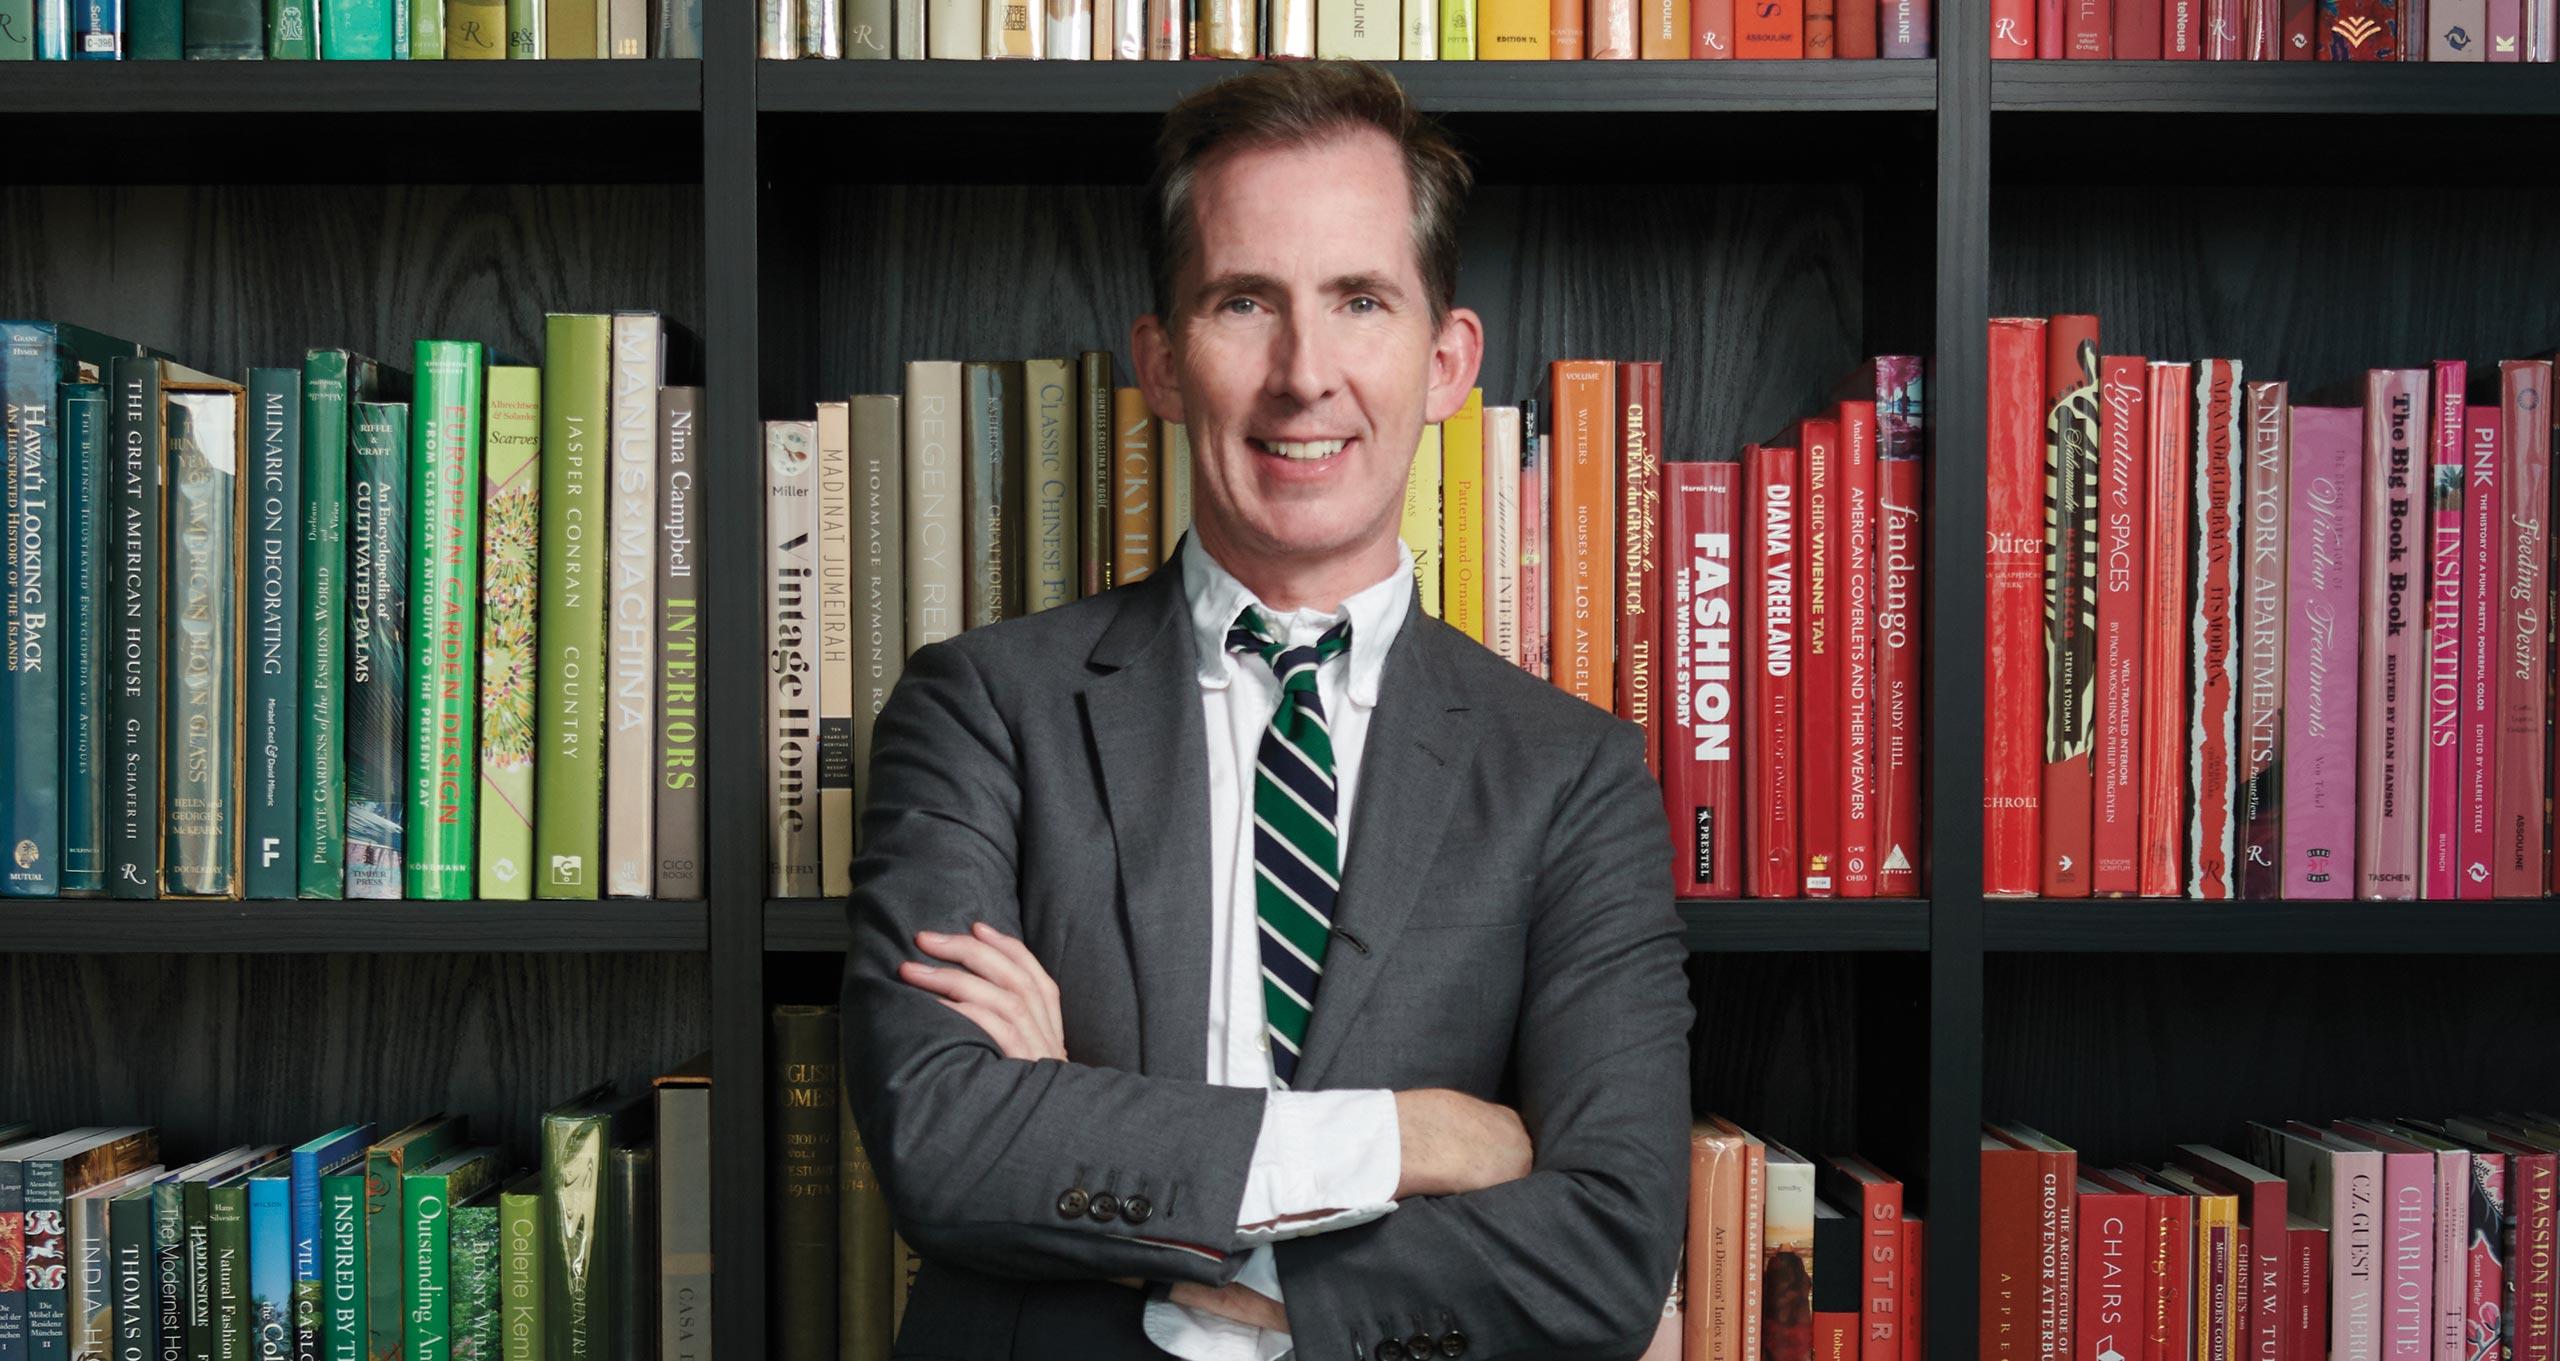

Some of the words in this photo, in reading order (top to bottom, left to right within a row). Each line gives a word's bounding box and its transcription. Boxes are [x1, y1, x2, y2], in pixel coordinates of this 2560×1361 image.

[461, 20, 495, 49] R
[854, 24, 885, 51] R
[1496, 35, 1523, 43] EDITION
[1703, 31, 1724, 51] R
[1996, 17, 2028, 47] R
[2176, 1, 2186, 53] teNeues
[127, 379, 143, 422] THE
[1565, 372, 1600, 381] VOLUME
[8, 403, 21, 422] AN
[489, 431, 540, 447] Scarves
[670, 410, 692, 465] Nina
[1577, 408, 1588, 465] WATTERS
[2103, 368, 2143, 508] Signature
[2256, 404, 2280, 474] NEW
[2391, 392, 2411, 441] The
[8, 424, 21, 511] ILLUSTRATED
[127, 430, 143, 500] GREAT
[264, 393, 285, 493] MLINARIC
[425, 421, 437, 464] FROM
[566, 416, 583, 496] JASPER
[1123, 418, 1149, 517] NICKY
[1627, 403, 1646, 484] CHÂTEAU
[1811, 444, 1825, 491] CHINA
[1853, 419, 1863, 466] Anderson
[2387, 446, 2410, 489] Big
[2473, 427, 2495, 488] PINK
[378, 481, 391, 503] An
[424, 470, 436, 550] CLASSICAL
[441, 404, 468, 564] EUROPEAN
[772, 486, 809, 497] Miller
[822, 448, 846, 544] MADINAT
[921, 394, 947, 569] REGENCY
[1458, 480, 1473, 533] Pattern
[1627, 486, 1641, 506] du
[8, 512, 20, 568] HISTORY
[264, 498, 284, 532] ON
[664, 470, 692, 578] Campbell
[869, 459, 882, 566] HOMMAGE
[1578, 504, 1589, 556] HOUSES
[1766, 483, 1792, 558] DIANA
[1811, 494, 1825, 531] CHIC
[1851, 487, 1865, 569] AMERICAN
[2255, 484, 2279, 566] YORK
[2305, 477, 2340, 592] Window
[2387, 497, 2409, 563] Book
[23, 499, 46, 606] LOOKING
[126, 506, 142, 619] AMERICAN
[356, 481, 372, 610] CULTIVATED
[375, 505, 392, 601] Encyclopedia
[565, 508, 582, 608] CONRAN
[1459, 536, 1473, 564] and
[1578, 560, 1588, 578] OF
[1625, 507, 1646, 616] GRAND-LUCÉ
[1811, 533, 1825, 615] VIVIENNE
[1879, 497, 1919, 649] fandango
[2109, 513, 2131, 593] SPACES
[2510, 513, 2541, 602] Feeding
[8, 571, 20, 588] OF
[8, 592, 20, 617] THE
[263, 540, 284, 675] DECORATING
[422, 557, 435, 641] ANTIQUITY
[822, 554, 847, 663] JUMEIRAH
[1576, 585, 1589, 619] LOS
[1677, 568, 1690, 602] THE
[2386, 572, 2408, 638] Book
[378, 602, 392, 621] of
[440, 576, 465, 700] GARDEN
[771, 531, 812, 699] Vintage
[870, 575, 883, 680] RAYMOND
[1677, 604, 1690, 669] WHOLE
[1766, 562, 1792, 677] VREELAND
[1811, 620, 1825, 655] TAM
[1850, 574, 1865, 661] COVERLETS
[2432, 526, 2462, 748] INSPIRATIONS
[8, 620, 20, 672] ISLANDS
[23, 612, 46, 673] BACK
[126, 627, 141, 698] HOUSE
[355, 617, 371, 684] PALMS
[421, 647, 433, 667] TO
[1694, 532, 1731, 761] FASHION
[2063, 651, 2074, 686] STEVEN
[2250, 575, 2277, 762] APARTMENTS
[2304, 599, 2336, 738] Treatments
[2514, 607, 2539, 681] Desire
[421, 673, 433, 706] THE
[562, 646, 581, 760] COUNTRY
[665, 598, 698, 790] INTERIORS
[1632, 640, 1649, 728] TIMOTHY
[1676, 670, 1690, 729] STORY
[1850, 663, 1864, 699] AND
[1891, 680, 1903, 731] SANDY
[2119, 659, 2131, 737] WELL-TRAVELLED
[2385, 653, 2397, 704] EDITED
[126, 718, 141, 747] GIL
[420, 707, 432, 771] PRESENT
[1850, 702, 1864, 748] THEIR
[2062, 687, 2073, 733] STOLMAN
[2385, 705, 2396, 724] BY
[2475, 723, 2485, 755] EDITED
[438, 713, 462, 825] DESIGN
[778, 705, 811, 834] Home
[1891, 736, 1903, 771] HILL
[2118, 738, 2130, 786] INTERIORS
[2384, 726, 2396, 760] DIAN
[2475, 756, 2485, 768] BY
[126, 752, 141, 818] SCHAFER
[419, 777, 431, 809] DAY
[1850, 749, 1864, 820] WEAVERS
[2383, 763, 2396, 818] HANSON
[2474, 768, 2484, 804] VALERIE
[2474, 804, 2484, 834] STEELE
[2513, 814, 2525, 872] ASSOULINE
[10, 873, 43, 882] MUTUAL
[1700, 825, 1711, 877] PRESTEL
[2367, 873, 2411, 882] TASCHEN
[2438, 832, 2447, 873] BULFINCH
[2350, 1173, 2371, 1210] C.Z.
[2531, 1165, 2549, 1180] A
[159, 1205, 180, 1240] The
[333, 1194, 355, 1301] INSPIRED
[1747, 1156, 1759, 1281] MEDITERRANEAN
[2042, 1173, 2057, 1279] GROSVENOR
[2060, 1206, 2070, 1233] THE
[2350, 1213, 2370, 1282] GUEST
[2530, 1186, 2551, 1284] PASSION
[80, 1237, 103, 1315] INDIA
[160, 1243, 181, 1331] Modernist
[189, 1222, 209, 1327] HADDONSTONE
[219, 1248, 237, 1300] Natural
[297, 1238, 313, 1295] VILLA
[412, 1195, 444, 1324] Outstanding
[512, 1218, 535, 1298] Celerie
[1871, 1203, 1896, 1342] SISTER
[2058, 1235, 2070, 1334] ARCHITECTURE
[2101, 1216, 2124, 1325] CHAIRS
[2395, 1185, 2423, 1356] CHARLOTTE
[2473, 1253, 2484, 1277] Susan
[121, 1244, 142, 1340] THOMAS
[679, 1287, 699, 1342] CASA
[1747, 1289, 1757, 1306] TO
[2214, 1283, 2224, 1325] OGDEN
[2472, 1278, 2483, 1306] Meller
[2530, 1291, 2549, 1337] FOR
[221, 1304, 237, 1360] Fashion
[336, 1307, 355, 1336] BY
[2058, 1337, 2069, 1355] OF
